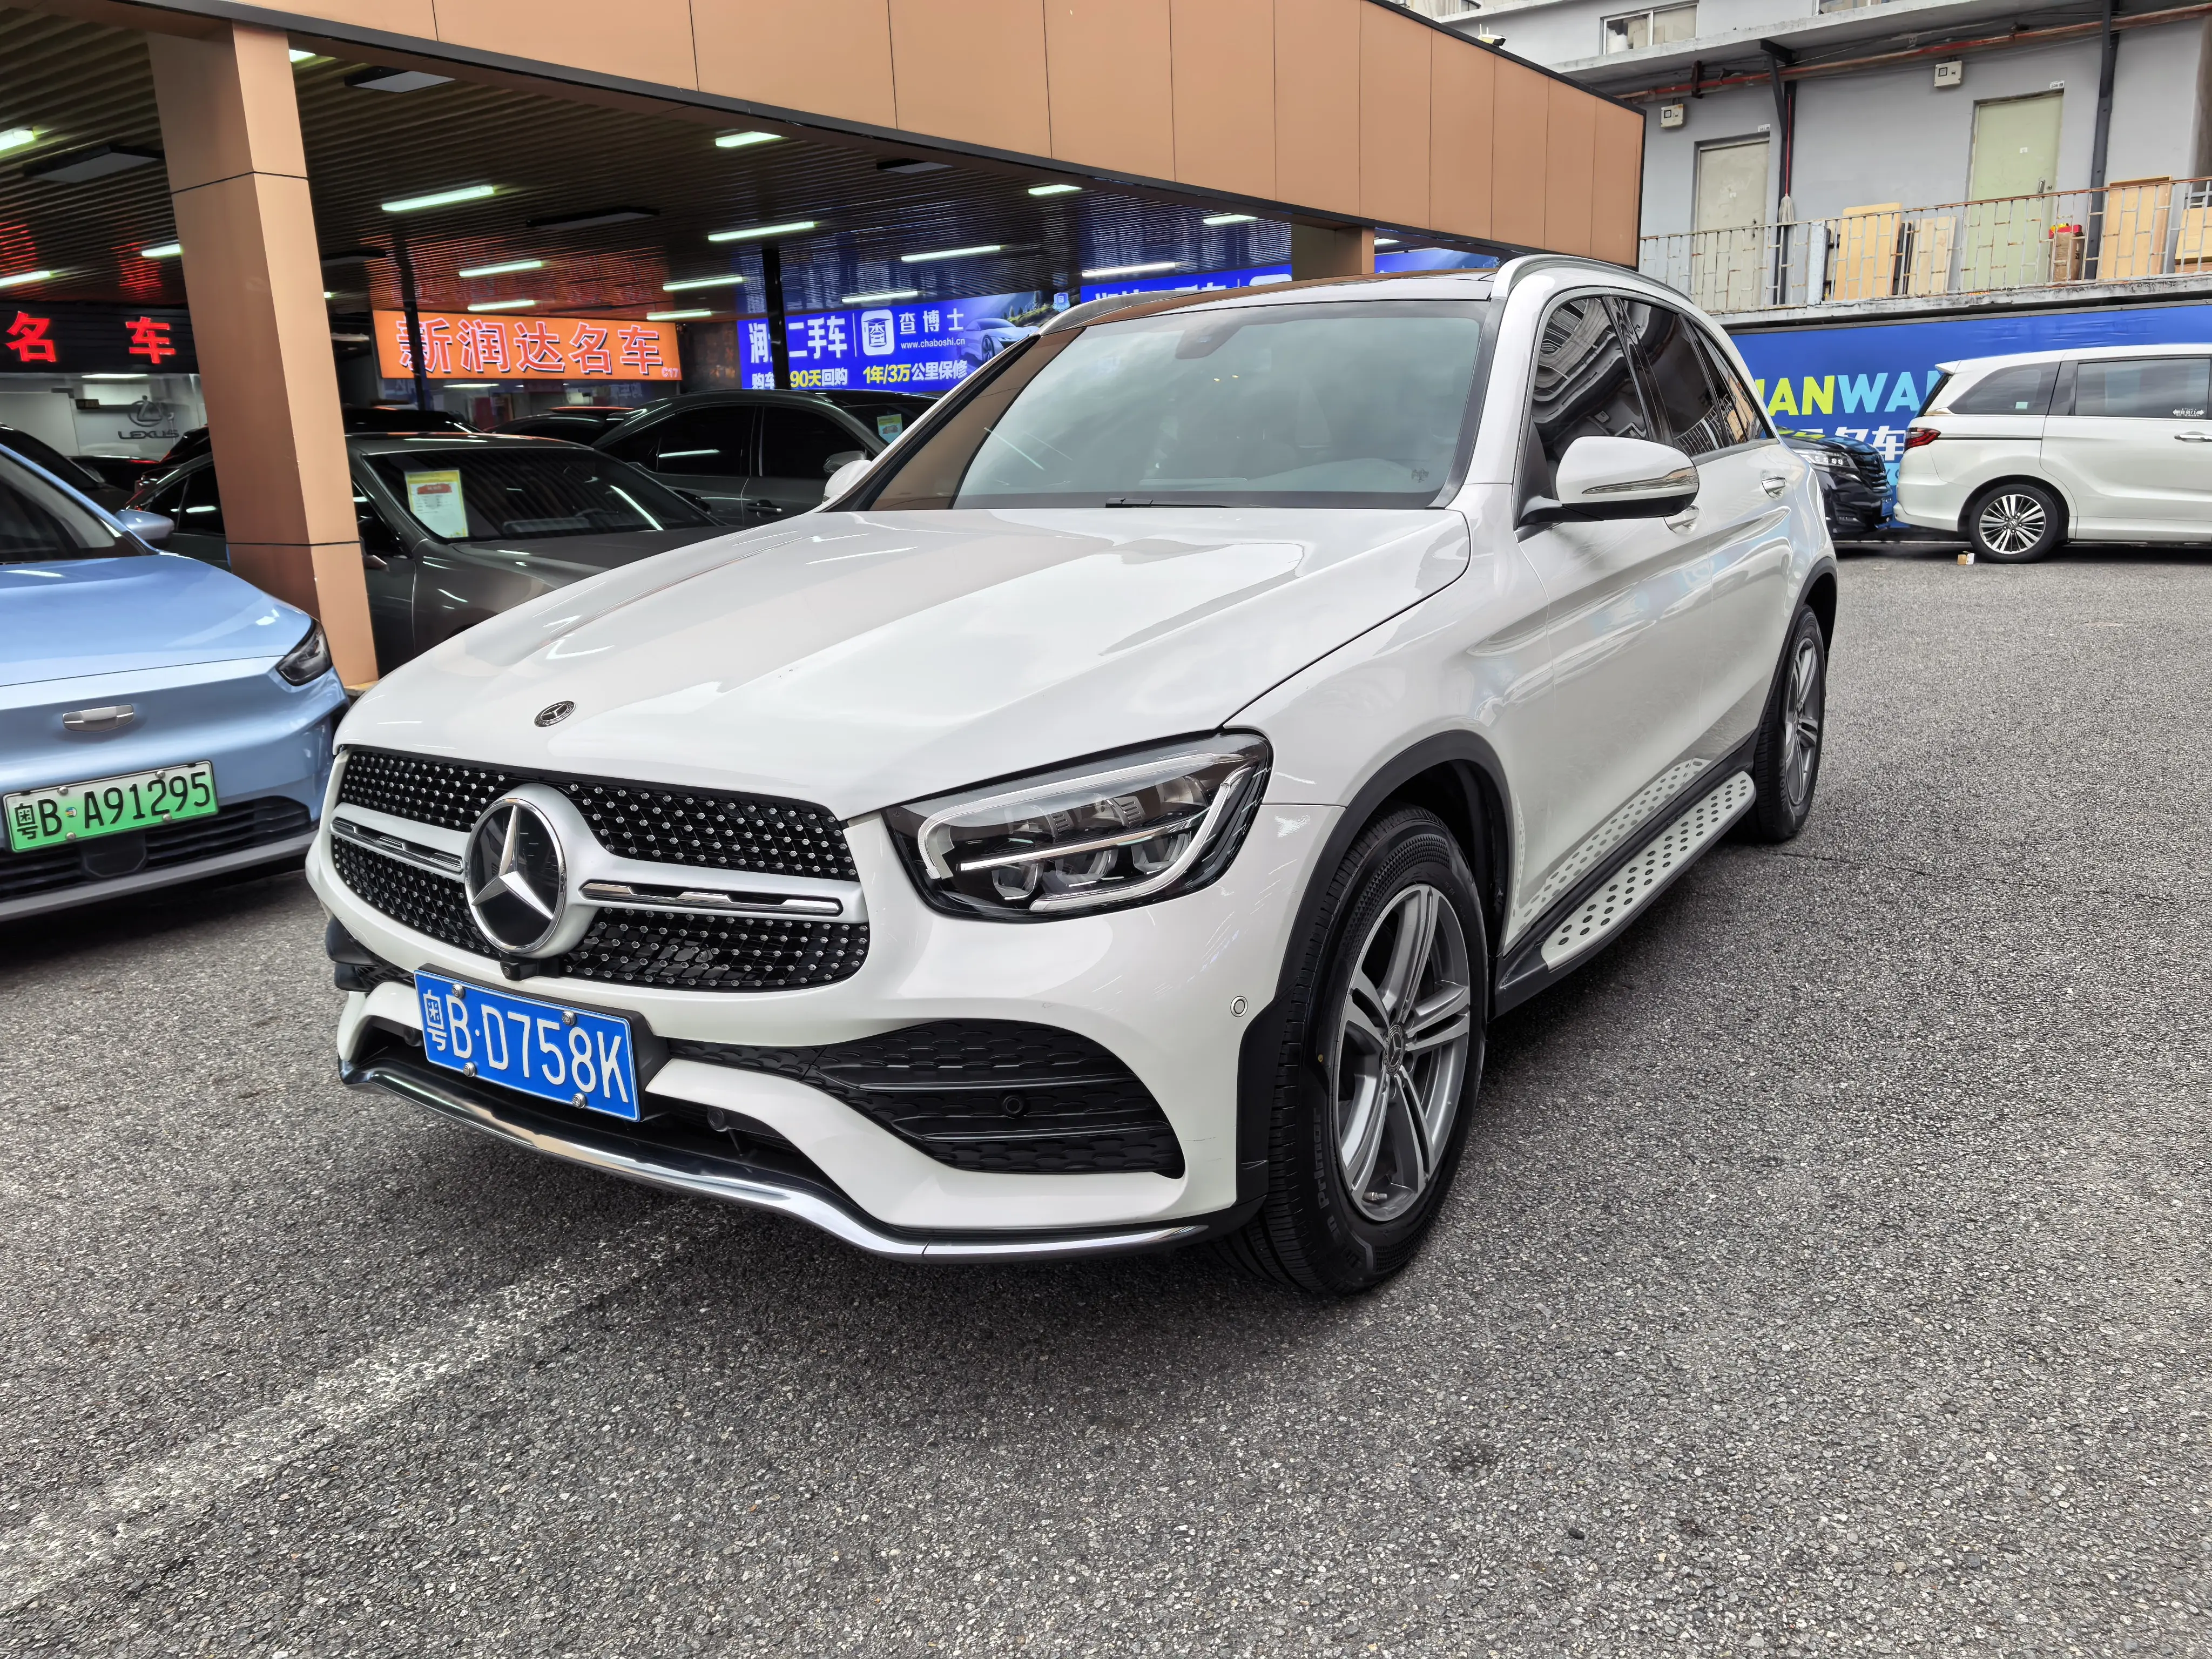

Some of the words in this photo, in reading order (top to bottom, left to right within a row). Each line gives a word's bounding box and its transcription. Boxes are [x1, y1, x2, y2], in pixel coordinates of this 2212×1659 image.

[899, 308, 964, 334] 查博士
[396, 316, 663, 375] 新润达名车
[900, 337, 966, 350] www.chaboshi.cn
[118, 431, 179, 440] LEXUS
